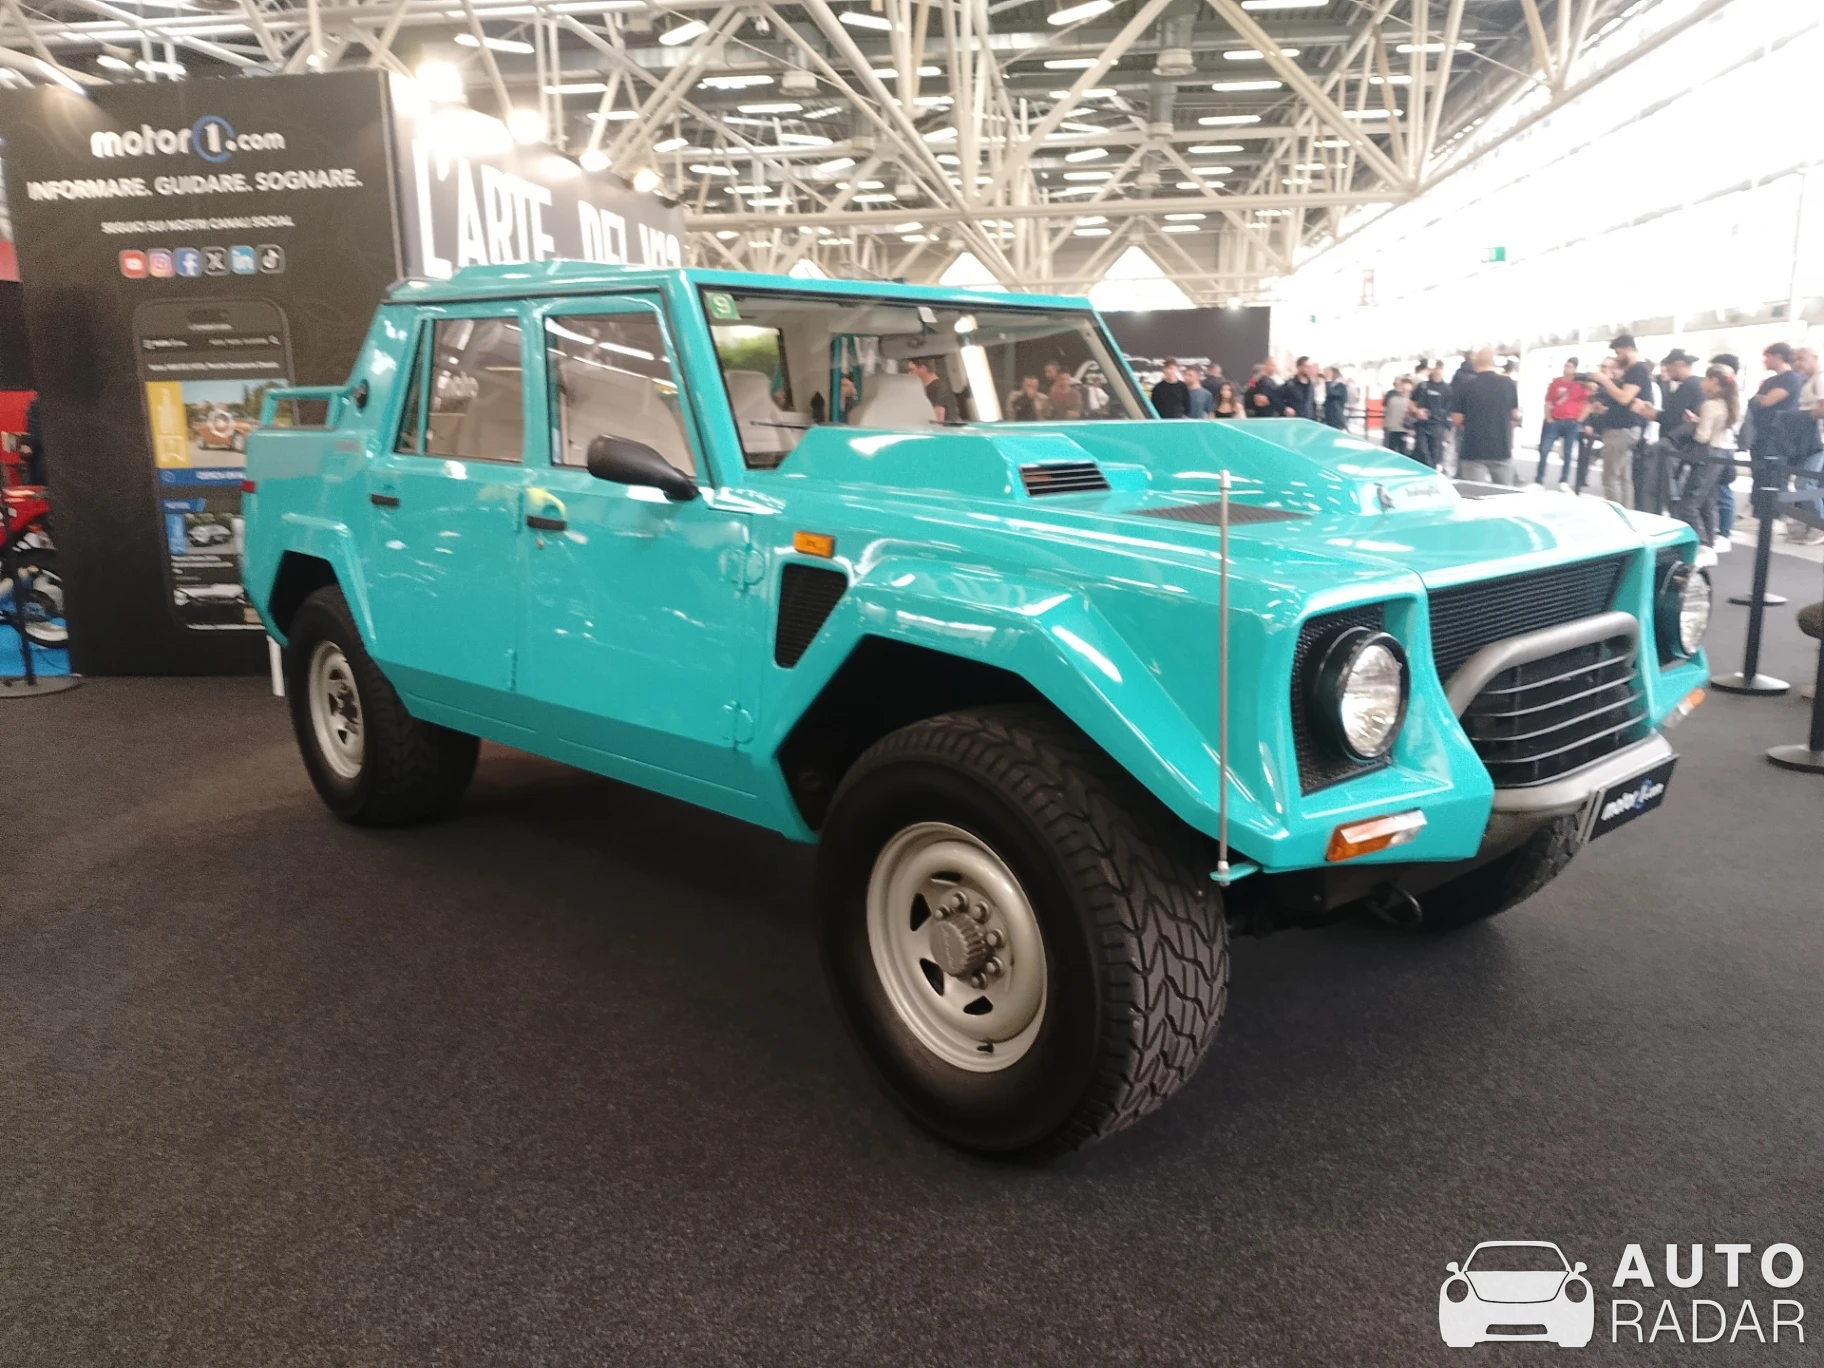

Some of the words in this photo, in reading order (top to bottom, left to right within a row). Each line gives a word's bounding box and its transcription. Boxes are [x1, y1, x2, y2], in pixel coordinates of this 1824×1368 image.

[90, 117, 286, 161] motor1.com
[27, 177, 153, 201] INFORMARE.
[154, 172, 253, 196] GUIDARE.
[255, 167, 364, 192] SOGNARE.
